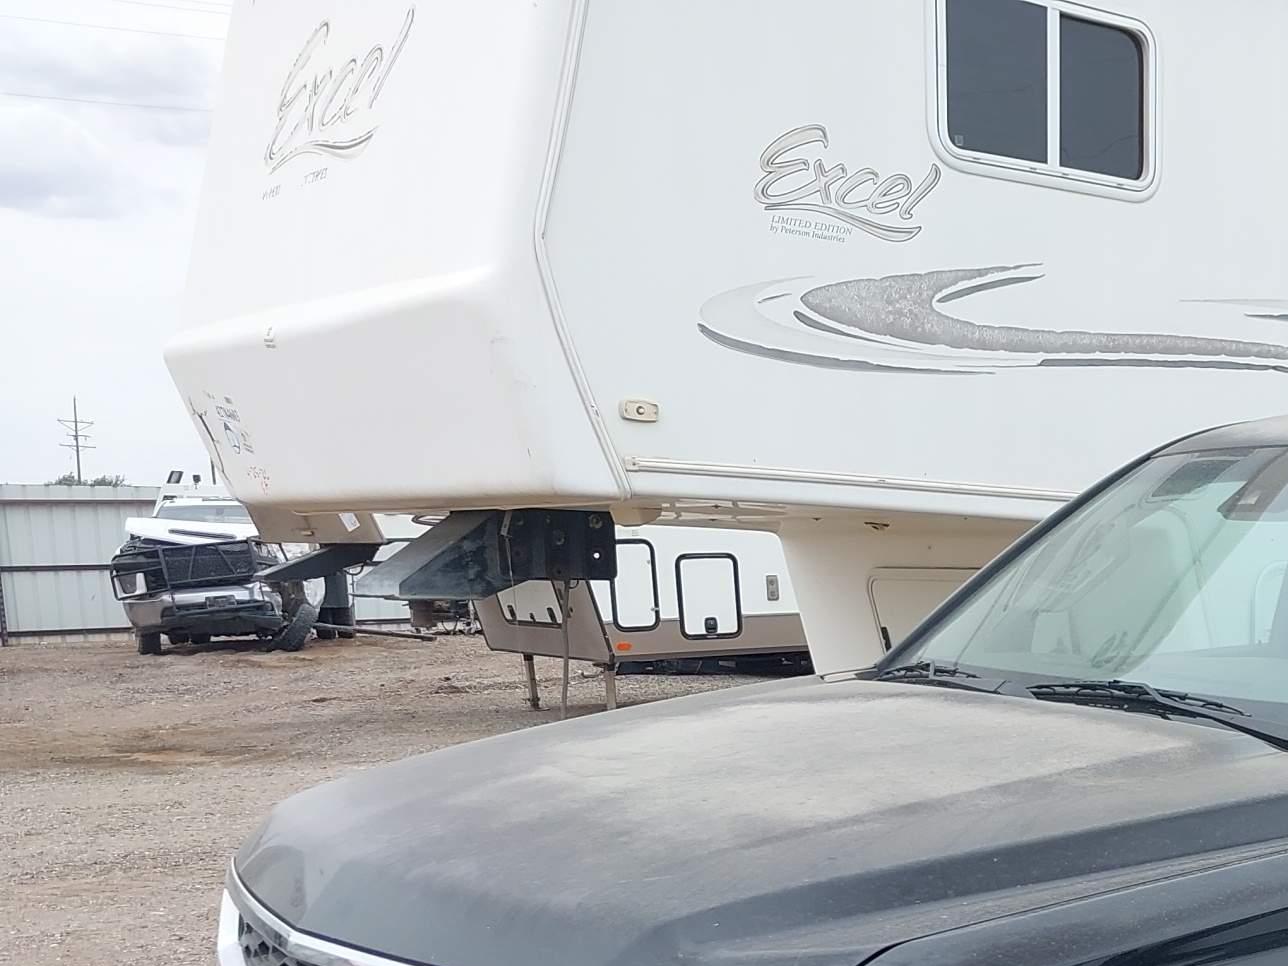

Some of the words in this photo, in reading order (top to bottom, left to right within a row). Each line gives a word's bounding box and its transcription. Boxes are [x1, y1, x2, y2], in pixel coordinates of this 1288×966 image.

[754, 123, 942, 220] Excel
[771, 214, 812, 229] LIMITED
[814, 221, 853, 236] EDITION
